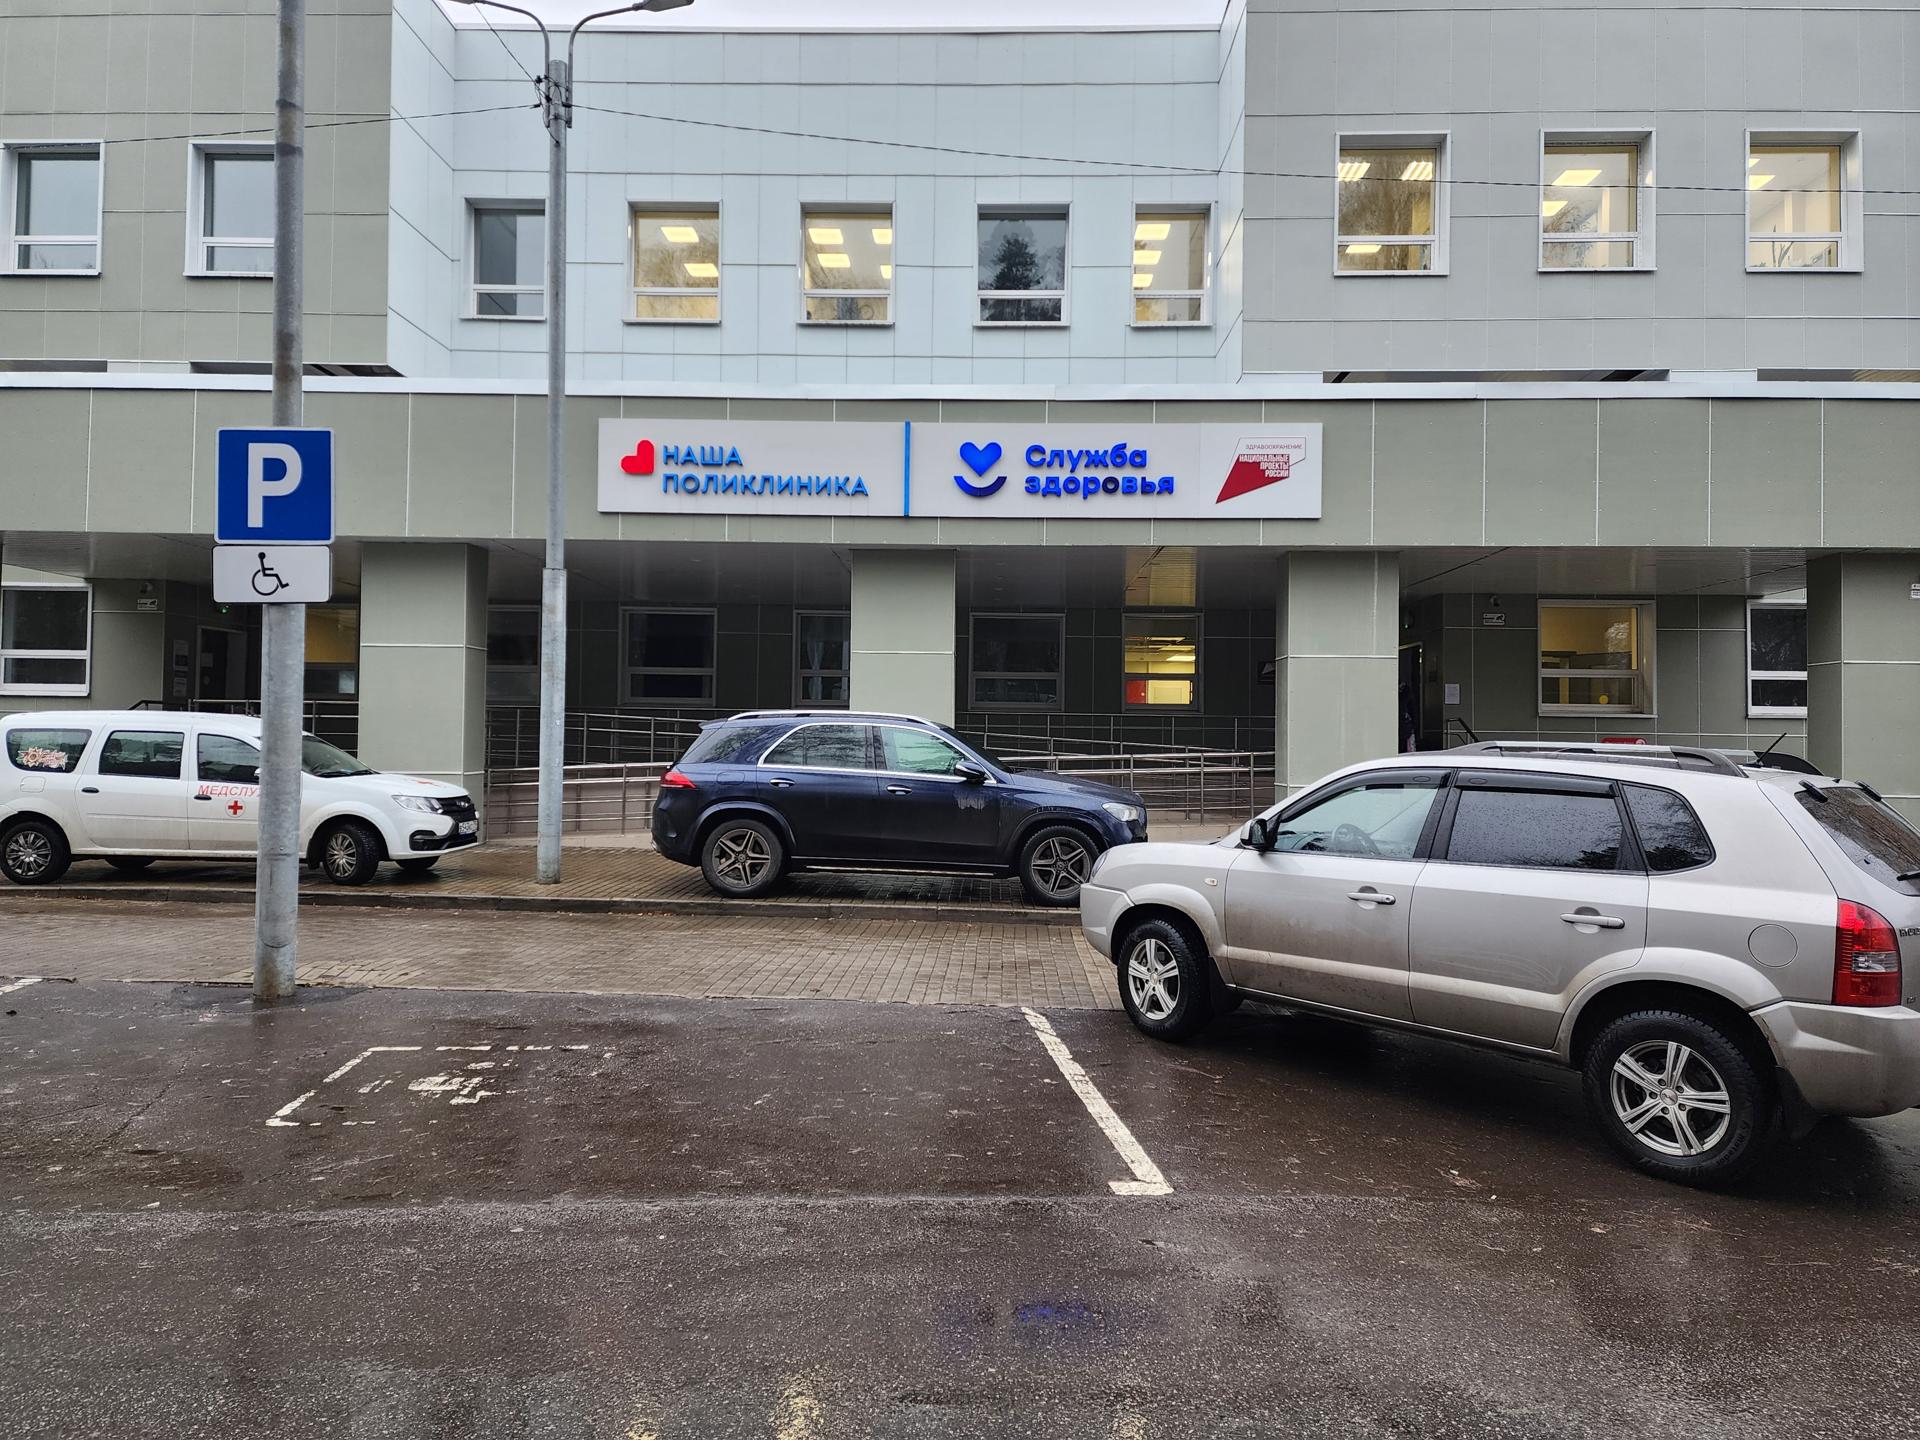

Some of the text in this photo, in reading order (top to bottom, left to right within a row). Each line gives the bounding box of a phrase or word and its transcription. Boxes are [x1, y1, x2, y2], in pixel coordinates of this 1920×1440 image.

[662, 445, 743, 466] НАША
[1025, 442, 1147, 473] Служба
[1239, 454, 1289, 462] НАЦИОНАЛЬНЫЕ
[1260, 462, 1289, 470] ПРОЕКТЫ
[1264, 469, 1289, 477] РОССИИ
[247, 442, 302, 528] P
[661, 473, 869, 497] ПОЛИКЛИНИКА
[1024, 476, 1175, 500] здоровья
[198, 785, 260, 798] МЕДСЛУ
